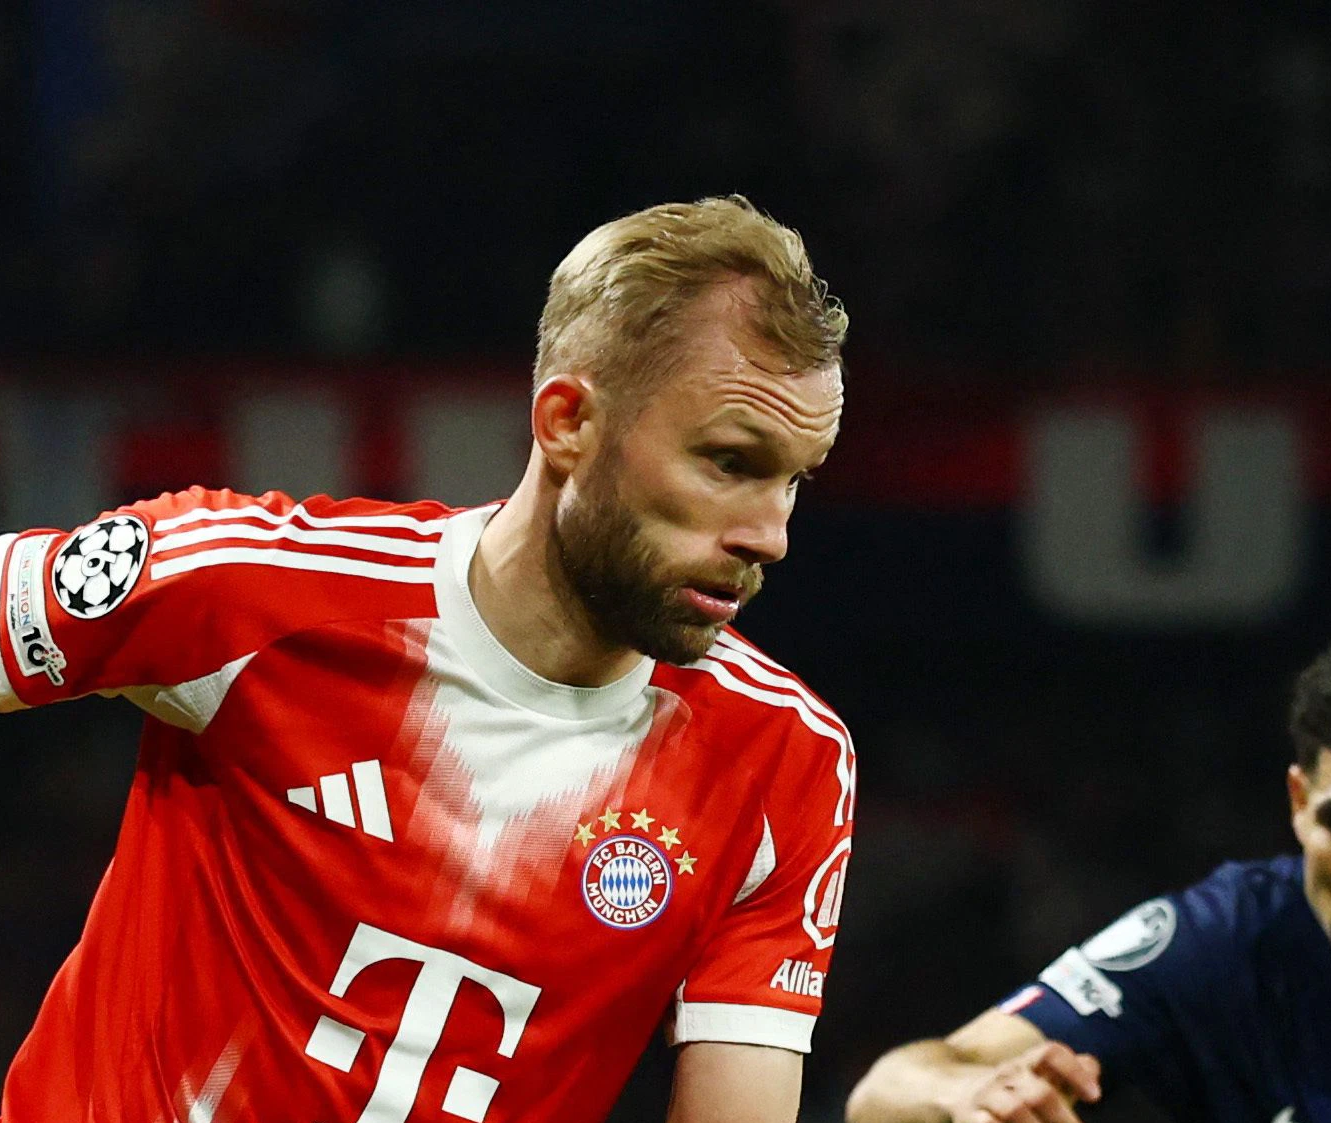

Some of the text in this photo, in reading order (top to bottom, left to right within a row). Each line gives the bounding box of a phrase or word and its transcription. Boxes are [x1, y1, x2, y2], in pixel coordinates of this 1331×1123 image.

[22, 626, 47, 667] 10
[592, 842, 666, 885] FC BAYERN
[770, 958, 827, 998] Allia
